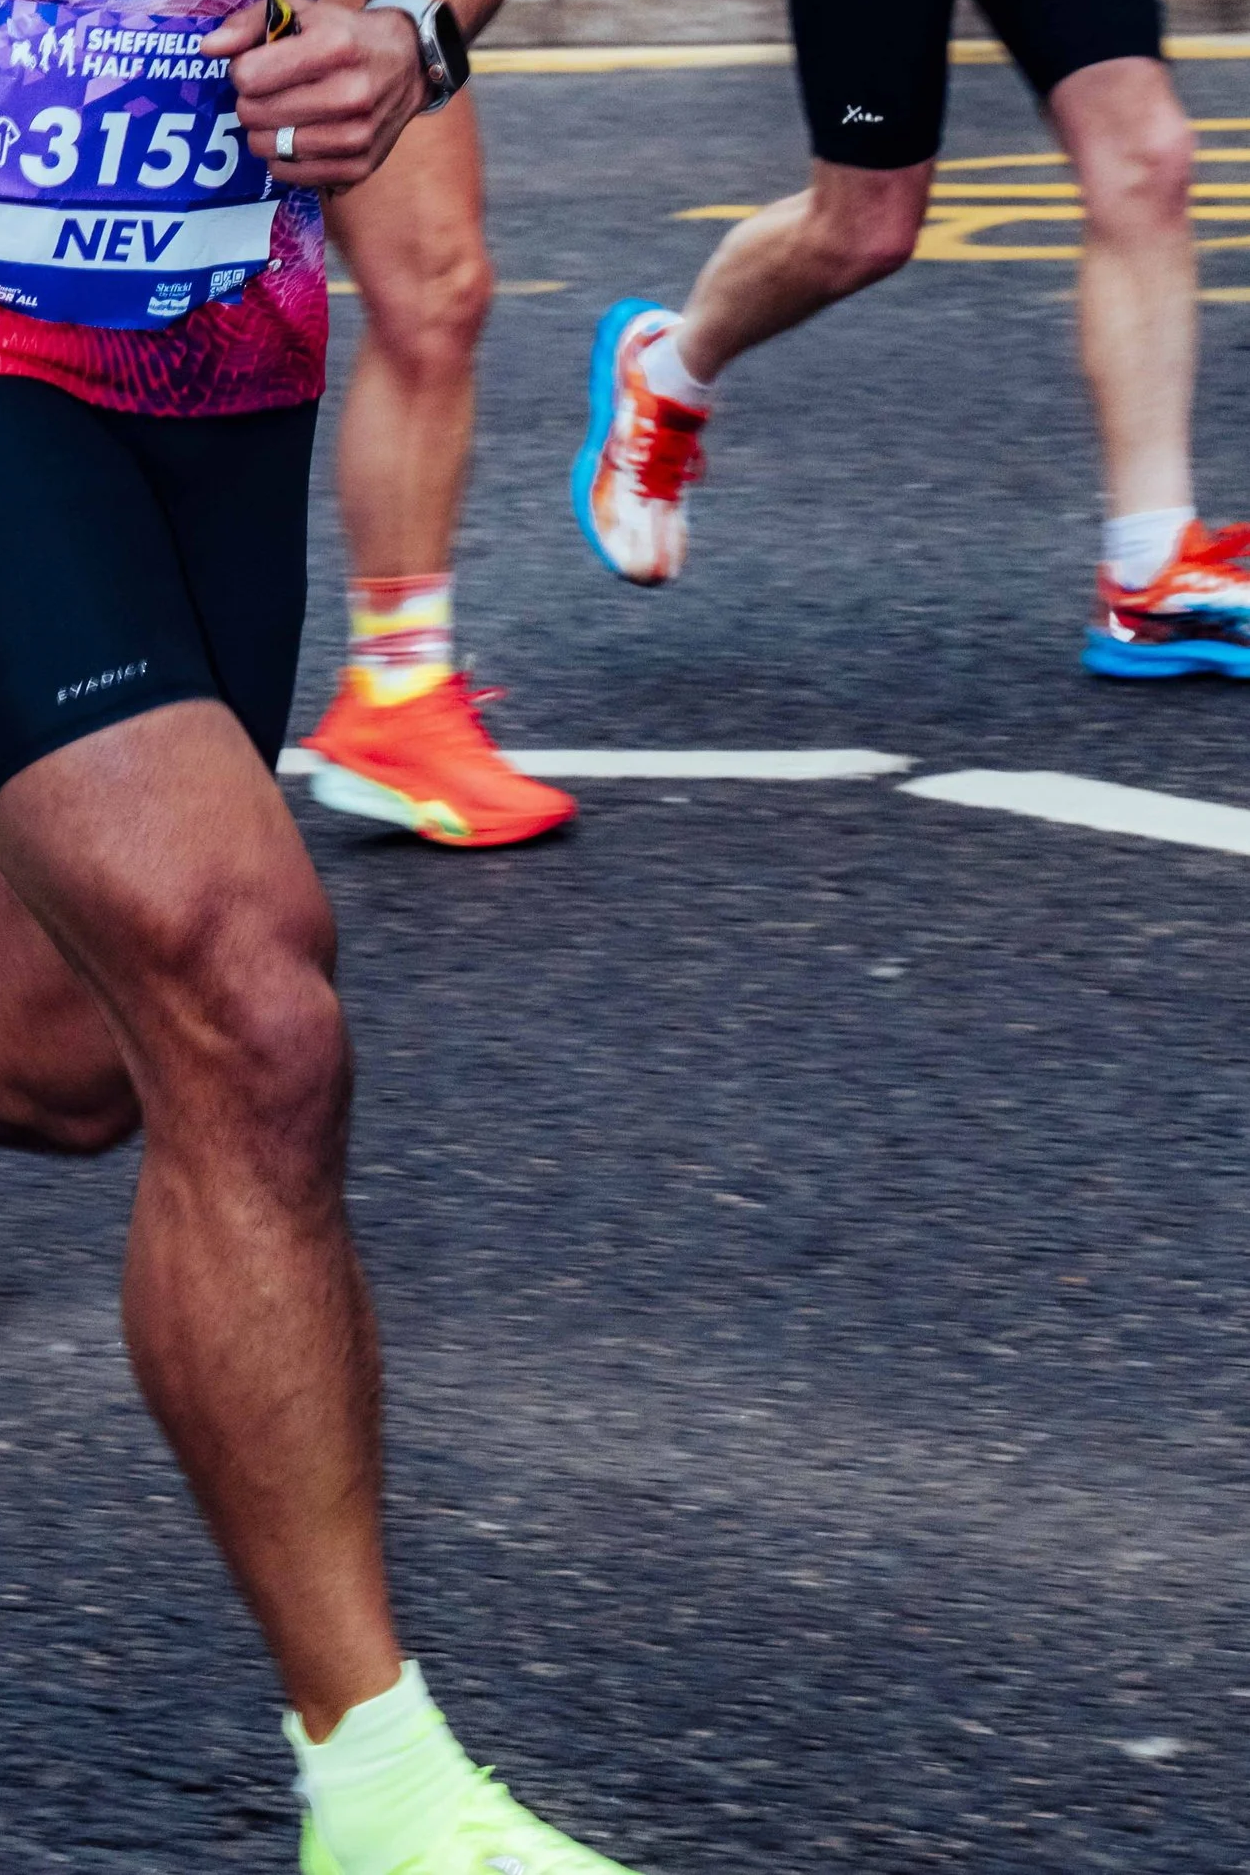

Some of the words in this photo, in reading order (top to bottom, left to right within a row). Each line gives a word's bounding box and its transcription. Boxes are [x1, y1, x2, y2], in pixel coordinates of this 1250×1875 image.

[86, 27, 204, 56] SHEFFIELD
[81, 54, 145, 79] HALF
[146, 58, 231, 80] MARAT
[19, 106, 242, 190] 3155
[52, 217, 185, 263] NEV
[16, 295, 38, 307] ALL
